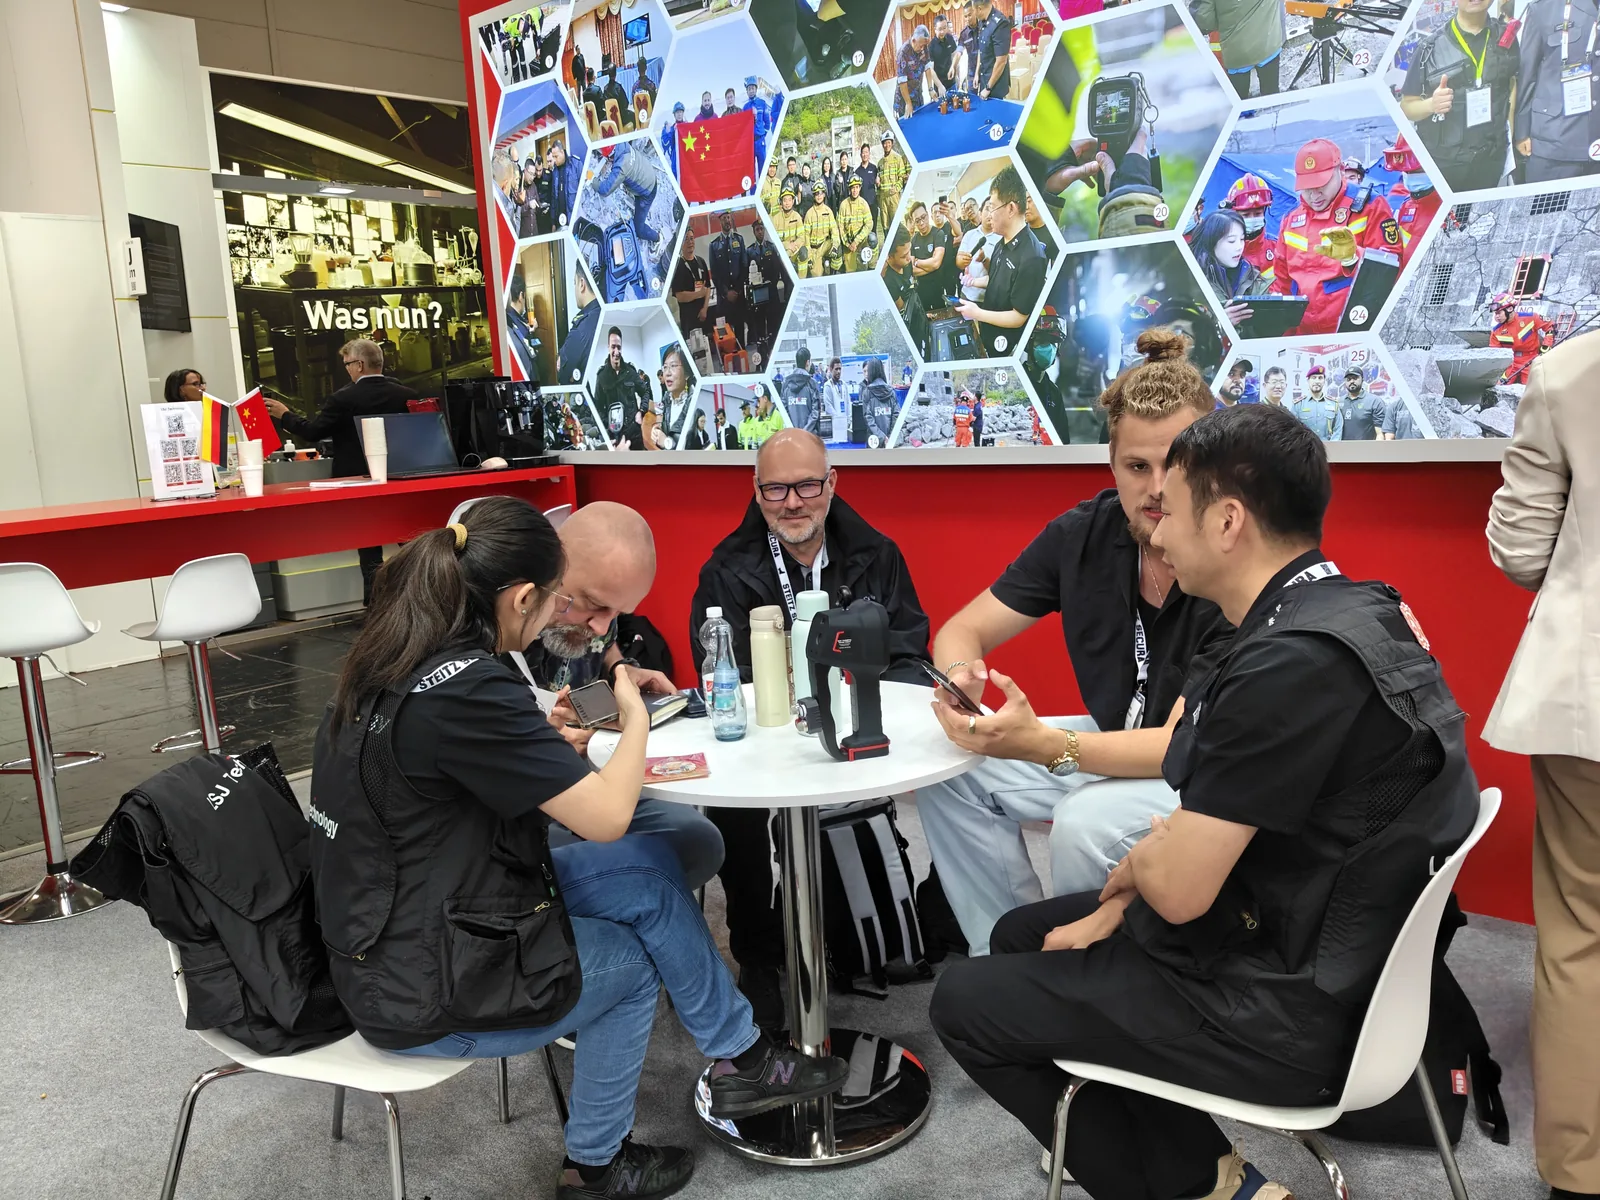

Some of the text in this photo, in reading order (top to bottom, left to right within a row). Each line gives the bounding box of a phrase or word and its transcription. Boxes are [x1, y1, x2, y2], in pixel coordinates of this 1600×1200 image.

[854, 53, 862, 64] 12
[1355, 52, 1369, 66] 23
[992, 127, 1002, 138] 16
[1156, 206, 1168, 218] 20
[863, 250, 871, 260] 13
[302, 300, 442, 330] Was nun?
[1352, 310, 1366, 320] 24
[996, 338, 1006, 348] 17
[1351, 350, 1365, 362] 25
[997, 372, 1006, 382] 18
[782, 584, 796, 612] STEITZ
[419, 662, 462, 690] STEITZ
[768, 1060, 796, 1084] N
[616, 1169, 642, 1194] N
